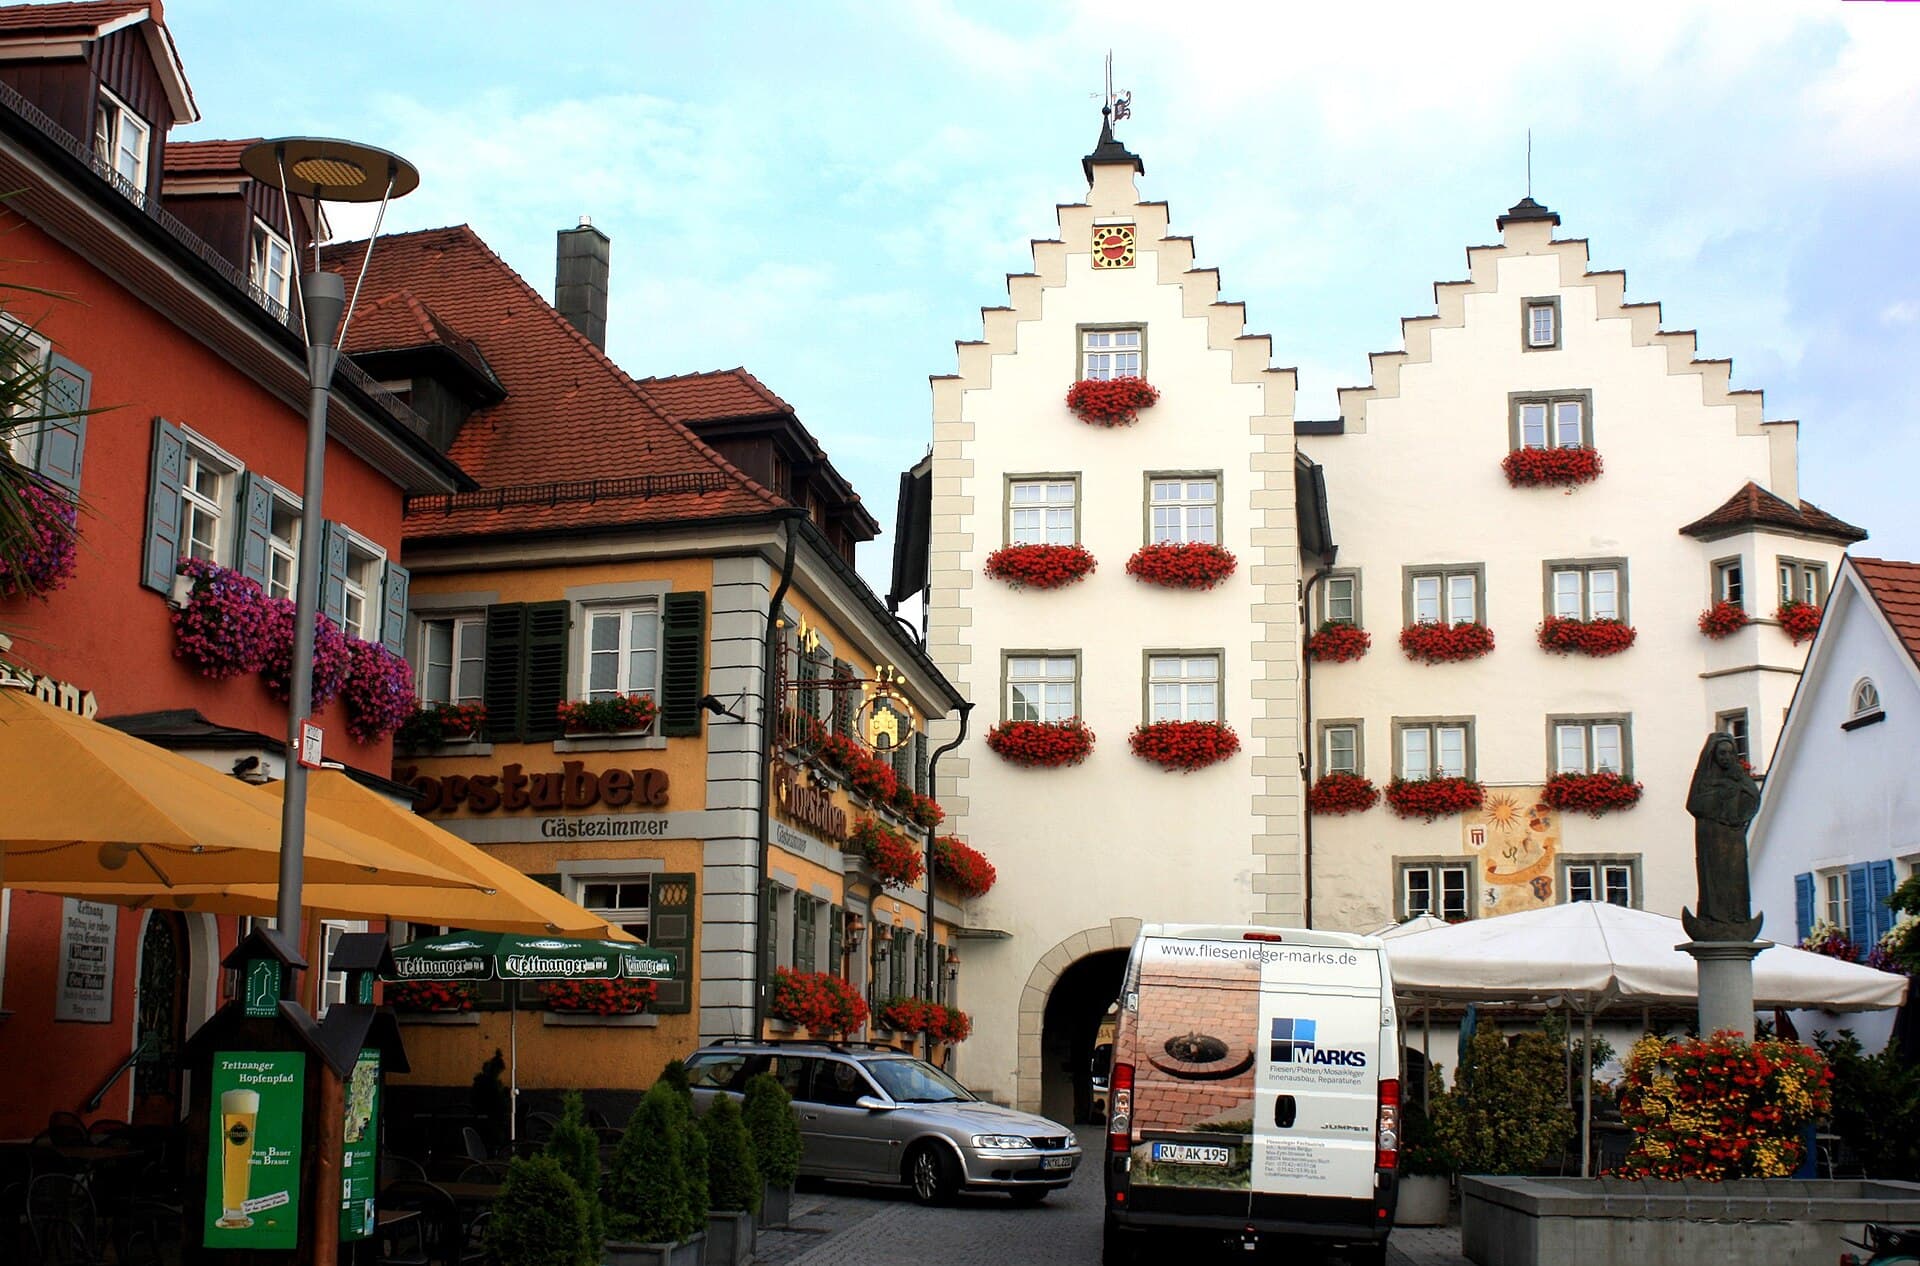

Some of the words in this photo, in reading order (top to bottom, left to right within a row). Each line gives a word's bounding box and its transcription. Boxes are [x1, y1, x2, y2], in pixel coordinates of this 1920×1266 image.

[541, 818, 668, 838] Gästezimmer
[1161, 944, 1357, 966] www.fliesenleger-marks.de
[395, 956, 465, 977] Tettnanger
[507, 955, 588, 976] Tettnanger
[1293, 1047, 1366, 1067] MARKS
[222, 1061, 274, 1073] Tettnanger
[239, 1073, 294, 1085] Hopfenpfad
[1318, 1075, 1362, 1086] Reparaturen
[269, 1147, 291, 1156] Bauer
[1161, 1145, 1177, 1158] RV
[1185, 1147, 1201, 1160] AK
[1203, 1148, 1227, 1162] 195
[264, 1156, 289, 1165] Brauer
